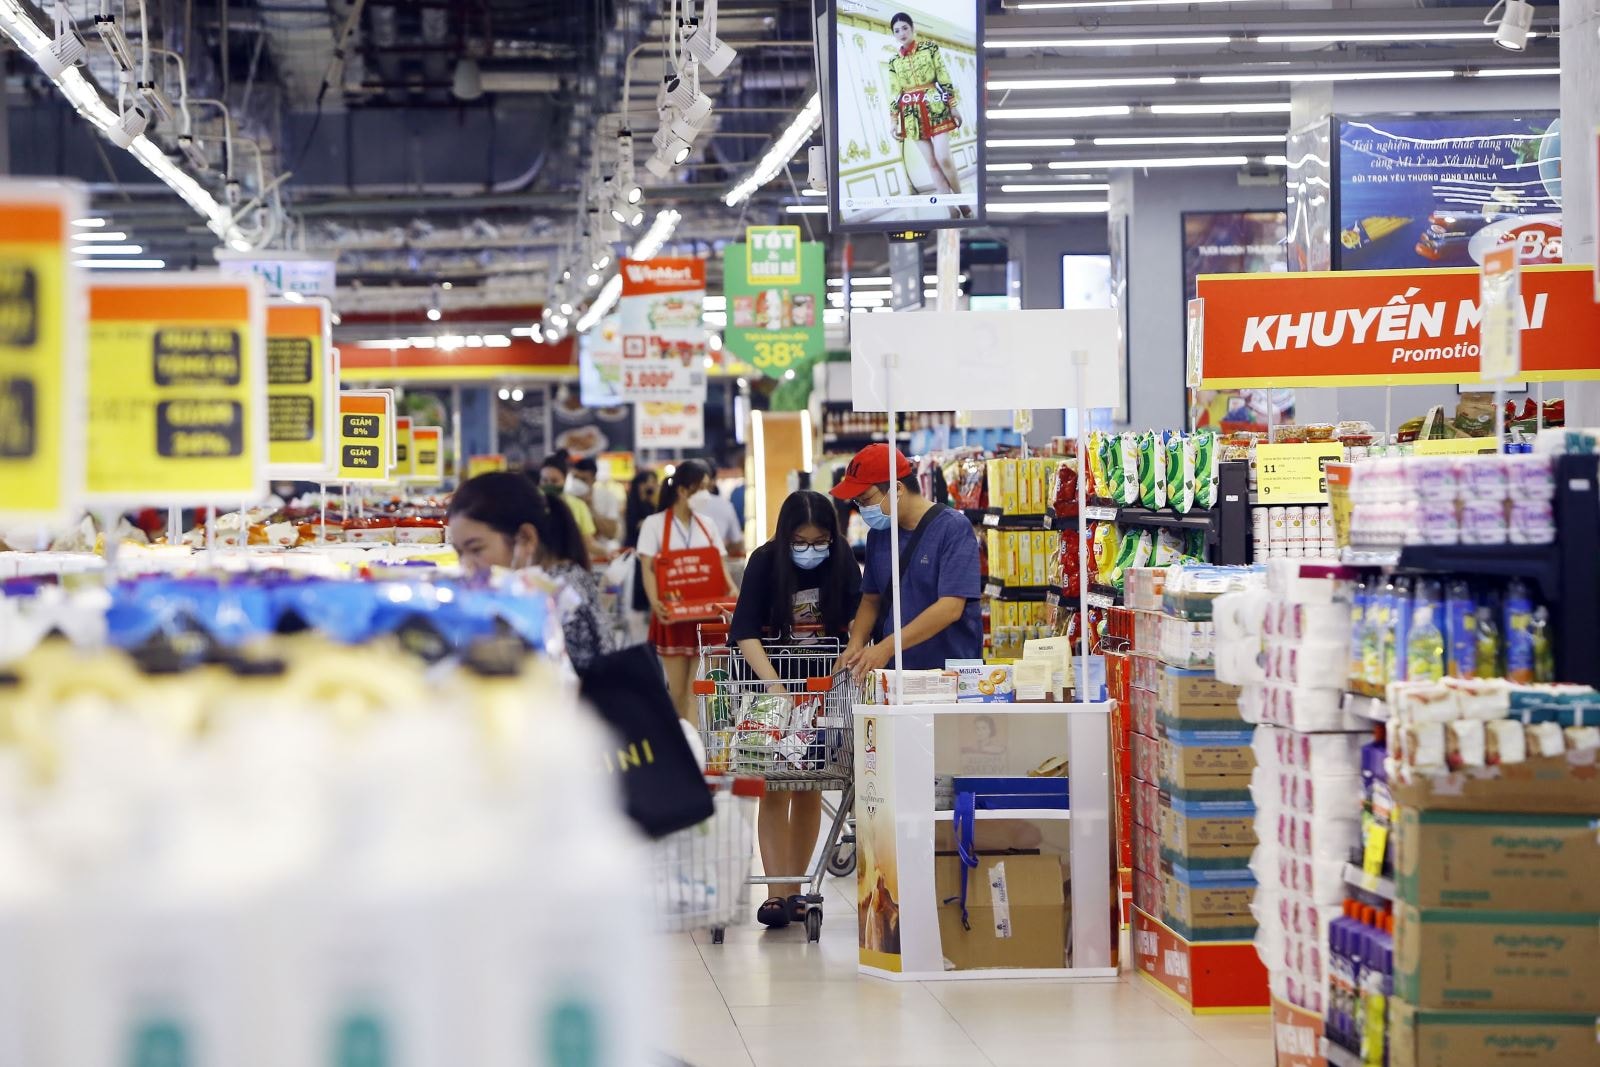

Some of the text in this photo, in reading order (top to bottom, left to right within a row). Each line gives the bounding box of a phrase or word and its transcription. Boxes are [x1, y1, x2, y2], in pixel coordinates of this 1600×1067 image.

[1241, 287, 1446, 353] KHUYẾN
[753, 341, 805, 368] 38%
[1391, 342, 1484, 363] Promotio
[350, 416, 372, 426] GIẢM
[353, 427, 368, 435] 8%
[350, 447, 371, 456] GIẢM
[353, 457, 368, 465] 8%
[1264, 464, 1276, 473] 11
[1263, 486, 1271, 494] 9
